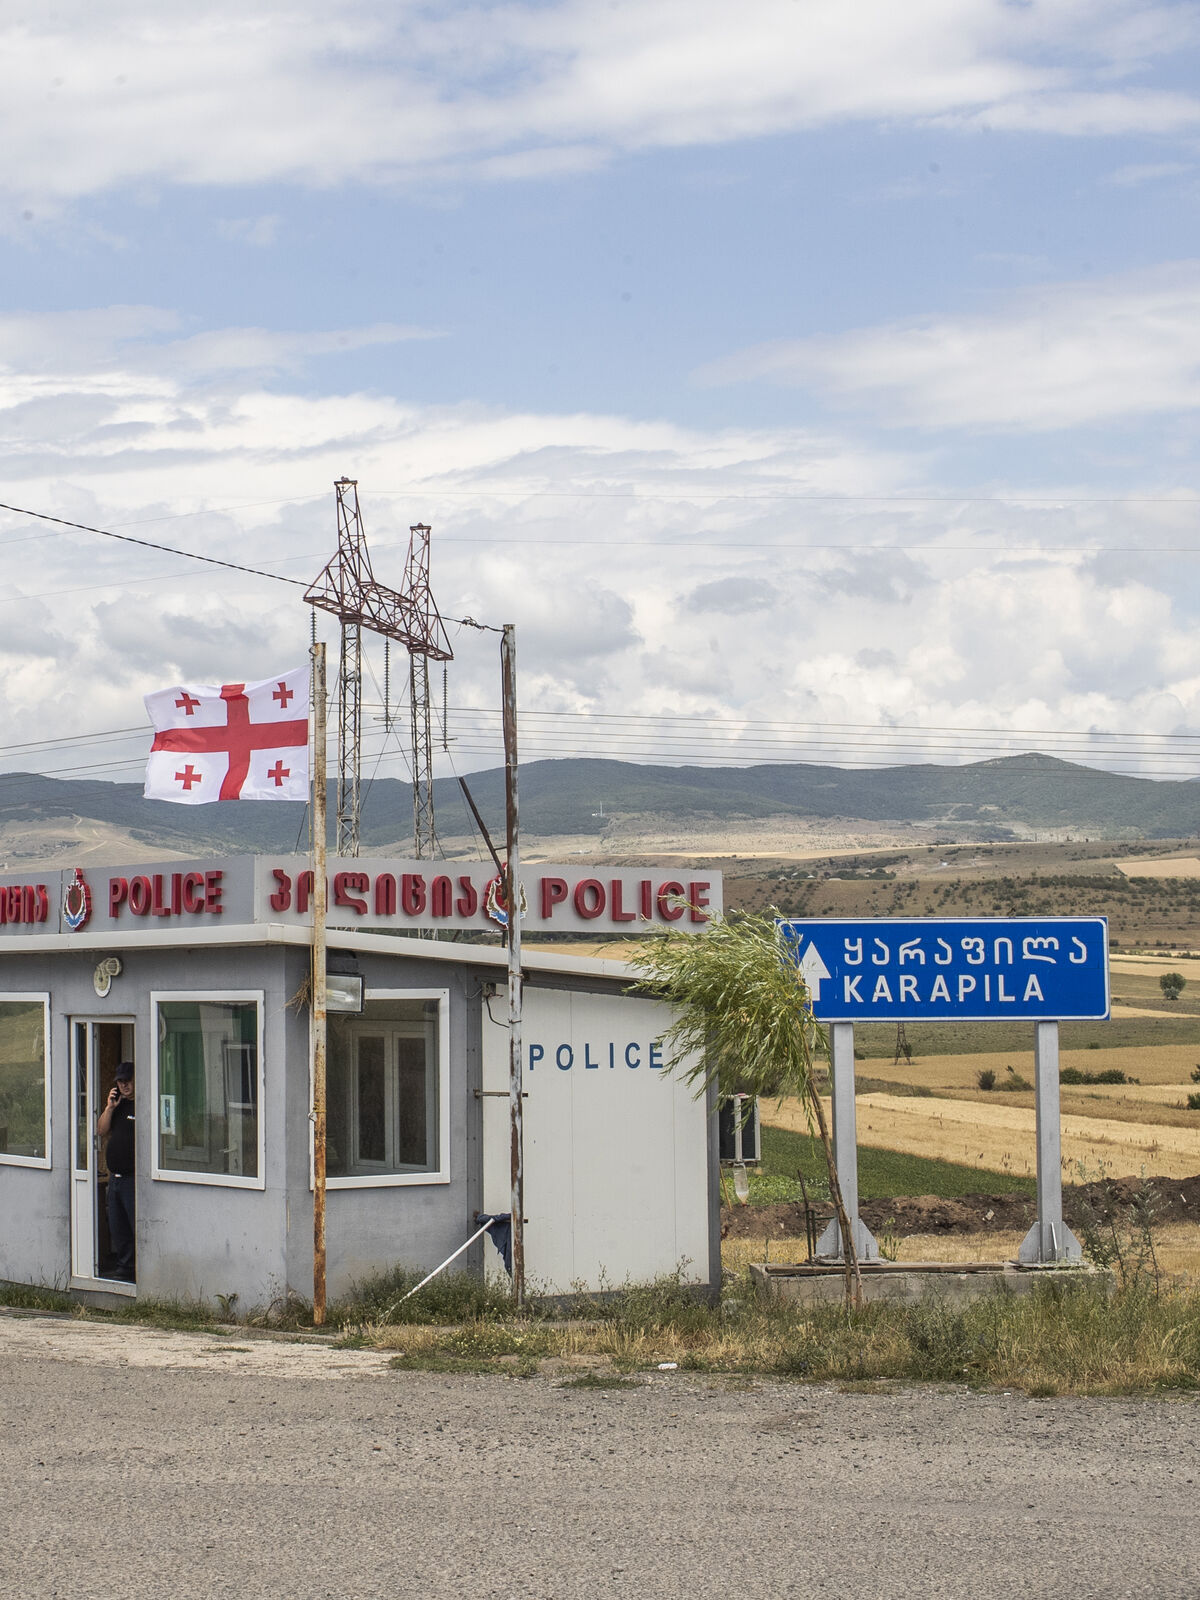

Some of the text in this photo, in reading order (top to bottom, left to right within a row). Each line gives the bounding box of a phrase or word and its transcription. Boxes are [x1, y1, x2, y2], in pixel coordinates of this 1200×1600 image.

[109, 871, 223, 918] POLICE
[541, 877, 711, 922] POLICE
[844, 936, 1088, 966] ყარაფილა
[843, 974, 1045, 1003] KARAPILA
[529, 1042, 663, 1071] POLICE
